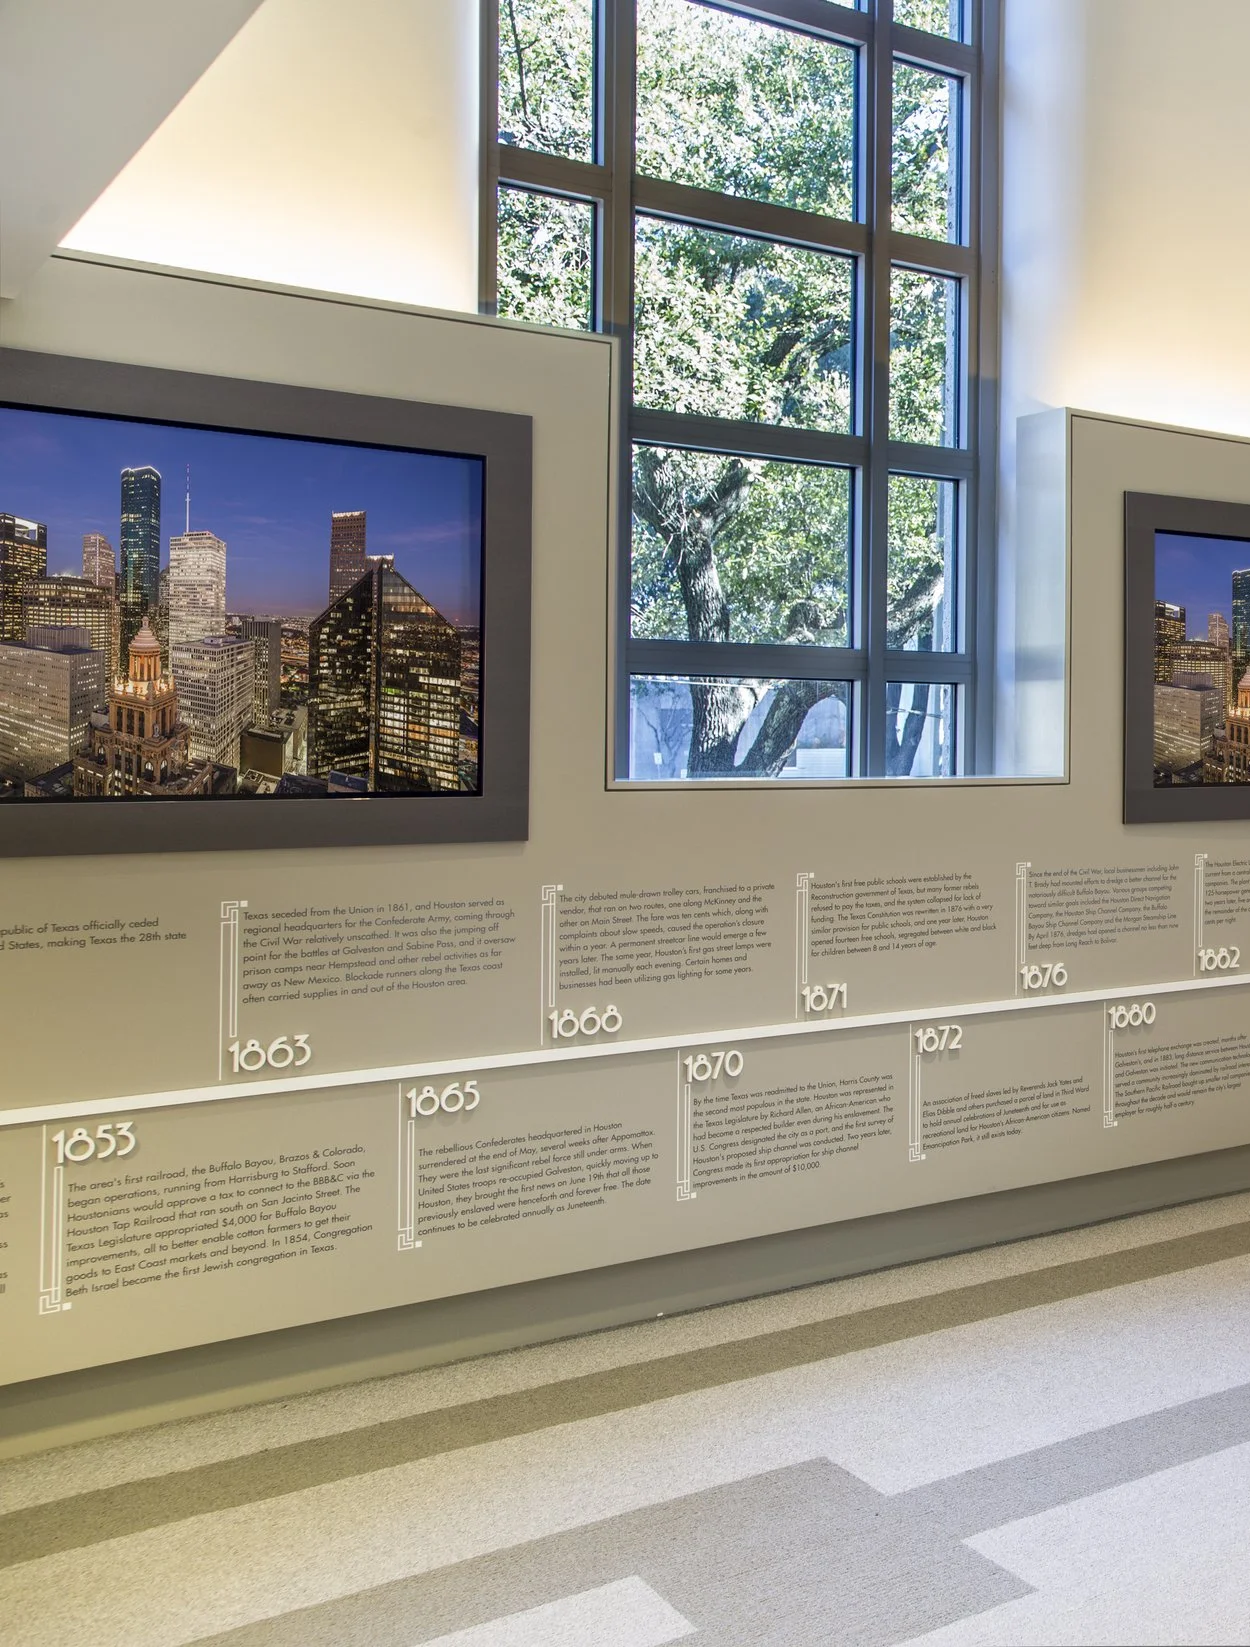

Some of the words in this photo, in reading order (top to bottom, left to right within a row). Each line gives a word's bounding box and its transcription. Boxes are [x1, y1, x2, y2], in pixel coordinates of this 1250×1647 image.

[560, 894, 573, 902] The
[575, 895, 587, 904] city
[589, 891, 618, 901] debuted
[663, 888, 684, 898] trolley
[703, 884, 737, 894] franchised
[753, 884, 775, 892] private
[811, 881, 841, 889] Houston's
[886, 877, 907, 885] schools
[923, 873, 954, 882] established
[955, 873, 962, 882] by
[243, 912, 269, 920] Texas
[272, 908, 308, 919] seceded
[310, 907, 331, 916] from
[333, 907, 346, 915] the
[349, 906, 374, 915] Union
[415, 901, 432, 910] and
[468, 897, 494, 907] served
[244, 923, 281, 936] regional
[284, 921, 342, 932] headquarters
[345, 919, 356, 928] for
[359, 918, 372, 927] the
[375, 916, 426, 926] Confederate
[454, 914, 483, 922] coming
[486, 909, 515, 924] through
[37, 923, 49, 933] of
[51, 923, 80, 933] Texas
[83, 919, 126, 931] officially
[129, 917, 159, 928] ceded
[47, 937, 86, 948] making
[90, 936, 118, 945] Texas
[120, 933, 136, 943] the
[139, 932, 161, 942] 28th
[165, 932, 187, 940] state
[1198, 946, 1240, 971] 1882
[1020, 962, 1067, 989] 1876
[801, 983, 847, 1012] 1871
[548, 1004, 622, 1038] 1868
[1108, 1001, 1156, 1029] 1880
[228, 1034, 312, 1073] 1863
[914, 1025, 963, 1053] 1872
[684, 1050, 743, 1083] 1870
[406, 1080, 480, 1118] 1865
[694, 1098, 702, 1107] By
[704, 1096, 714, 1104] the
[731, 1093, 749, 1101] Texas
[765, 1085, 798, 1096] readmitted
[859, 1076, 880, 1084] County
[52, 1122, 136, 1164] 1853
[419, 1148, 433, 1156] The
[436, 1143, 474, 1154] rebellious
[475, 1137, 526, 1149] Confederates
[528, 1126, 583, 1141] headquartered
[594, 1123, 623, 1132] Houston
[419, 1155, 467, 1170] surrendered
[469, 1155, 477, 1163] at
[479, 1152, 491, 1161] the
[493, 1149, 508, 1159] end
[510, 1147, 517, 1157] of
[541, 1140, 566, 1152] several
[569, 1138, 591, 1147] weeks
[592, 1135, 609, 1144] after
[68, 1183, 87, 1192] The
[90, 1178, 122, 1190] area's
[125, 1175, 143, 1184] first
[146, 1168, 189, 1181] railroad,
[192, 1166, 207, 1175] the
[209, 1160, 242, 1173] Buffalo
[245, 1159, 275, 1169] Bayou,
[280, 1154, 310, 1163] Brazos
[313, 1150, 320, 1159] &
[323, 1144, 366, 1157] Colorado,
[67, 1208, 130, 1222] Houstonians
[133, 1199, 164, 1212] would
[167, 1196, 207, 1209] approve
[248, 1178, 283, 1195] connect
[297, 1179, 311, 1188] the
[313, 1173, 344, 1186] BBB&C
[362, 1169, 375, 1178] the
[68, 1197, 101, 1209] began
[104, 1189, 160, 1204] operations,
[164, 1183, 201, 1193] running
[204, 1178, 226, 1188] from
[229, 1171, 279, 1184] Harrisburg
[293, 1162, 329, 1175] Stafford.
[334, 1160, 356, 1169] Soon
